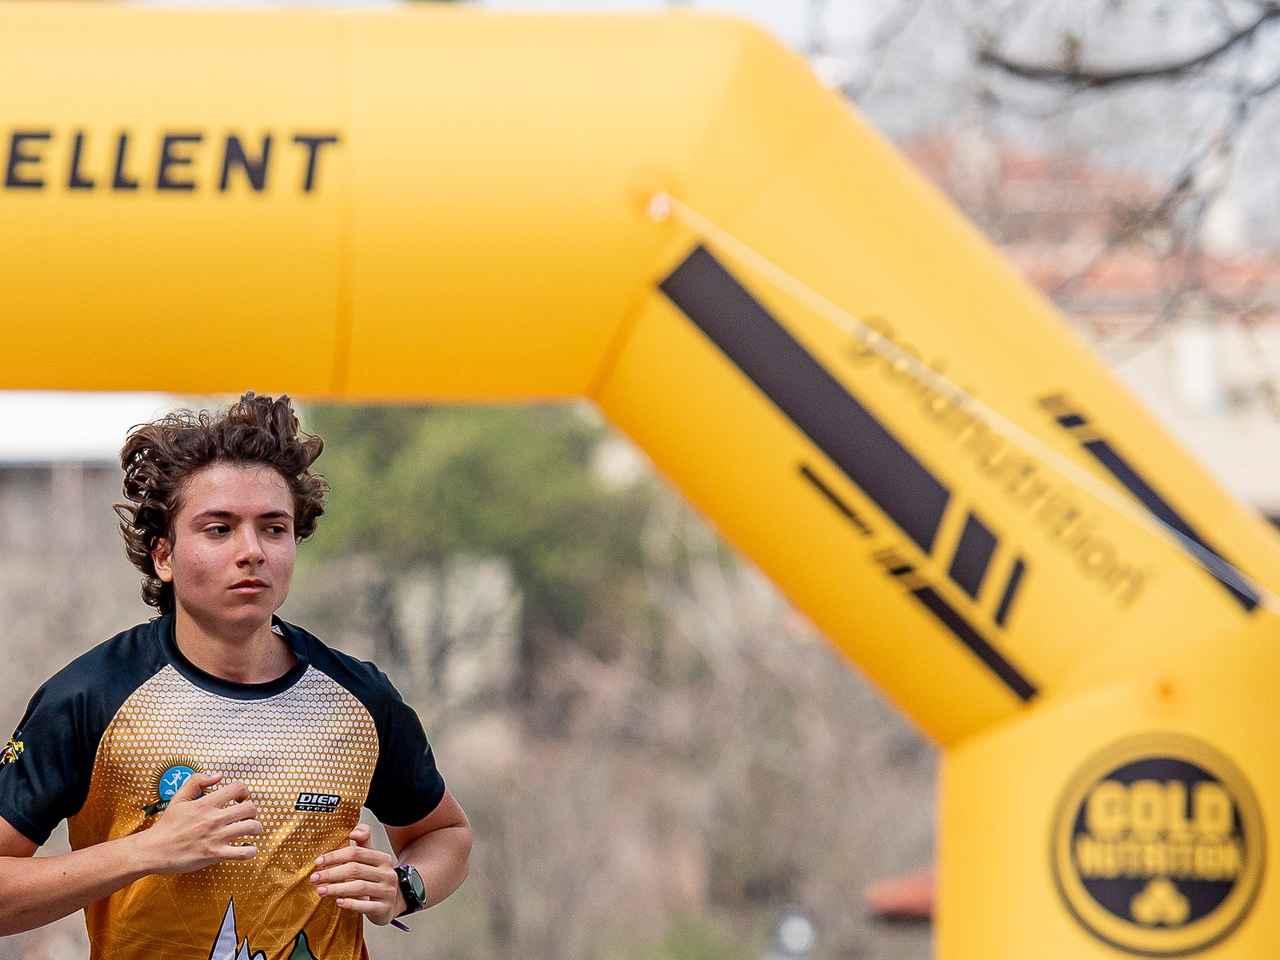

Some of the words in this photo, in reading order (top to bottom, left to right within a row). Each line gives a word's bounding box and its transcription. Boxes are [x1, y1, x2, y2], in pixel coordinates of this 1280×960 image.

[844, 314, 1151, 608] goldnutrition
[299, 793, 339, 805] DIEM
[1085, 779, 1234, 843] GOLD
